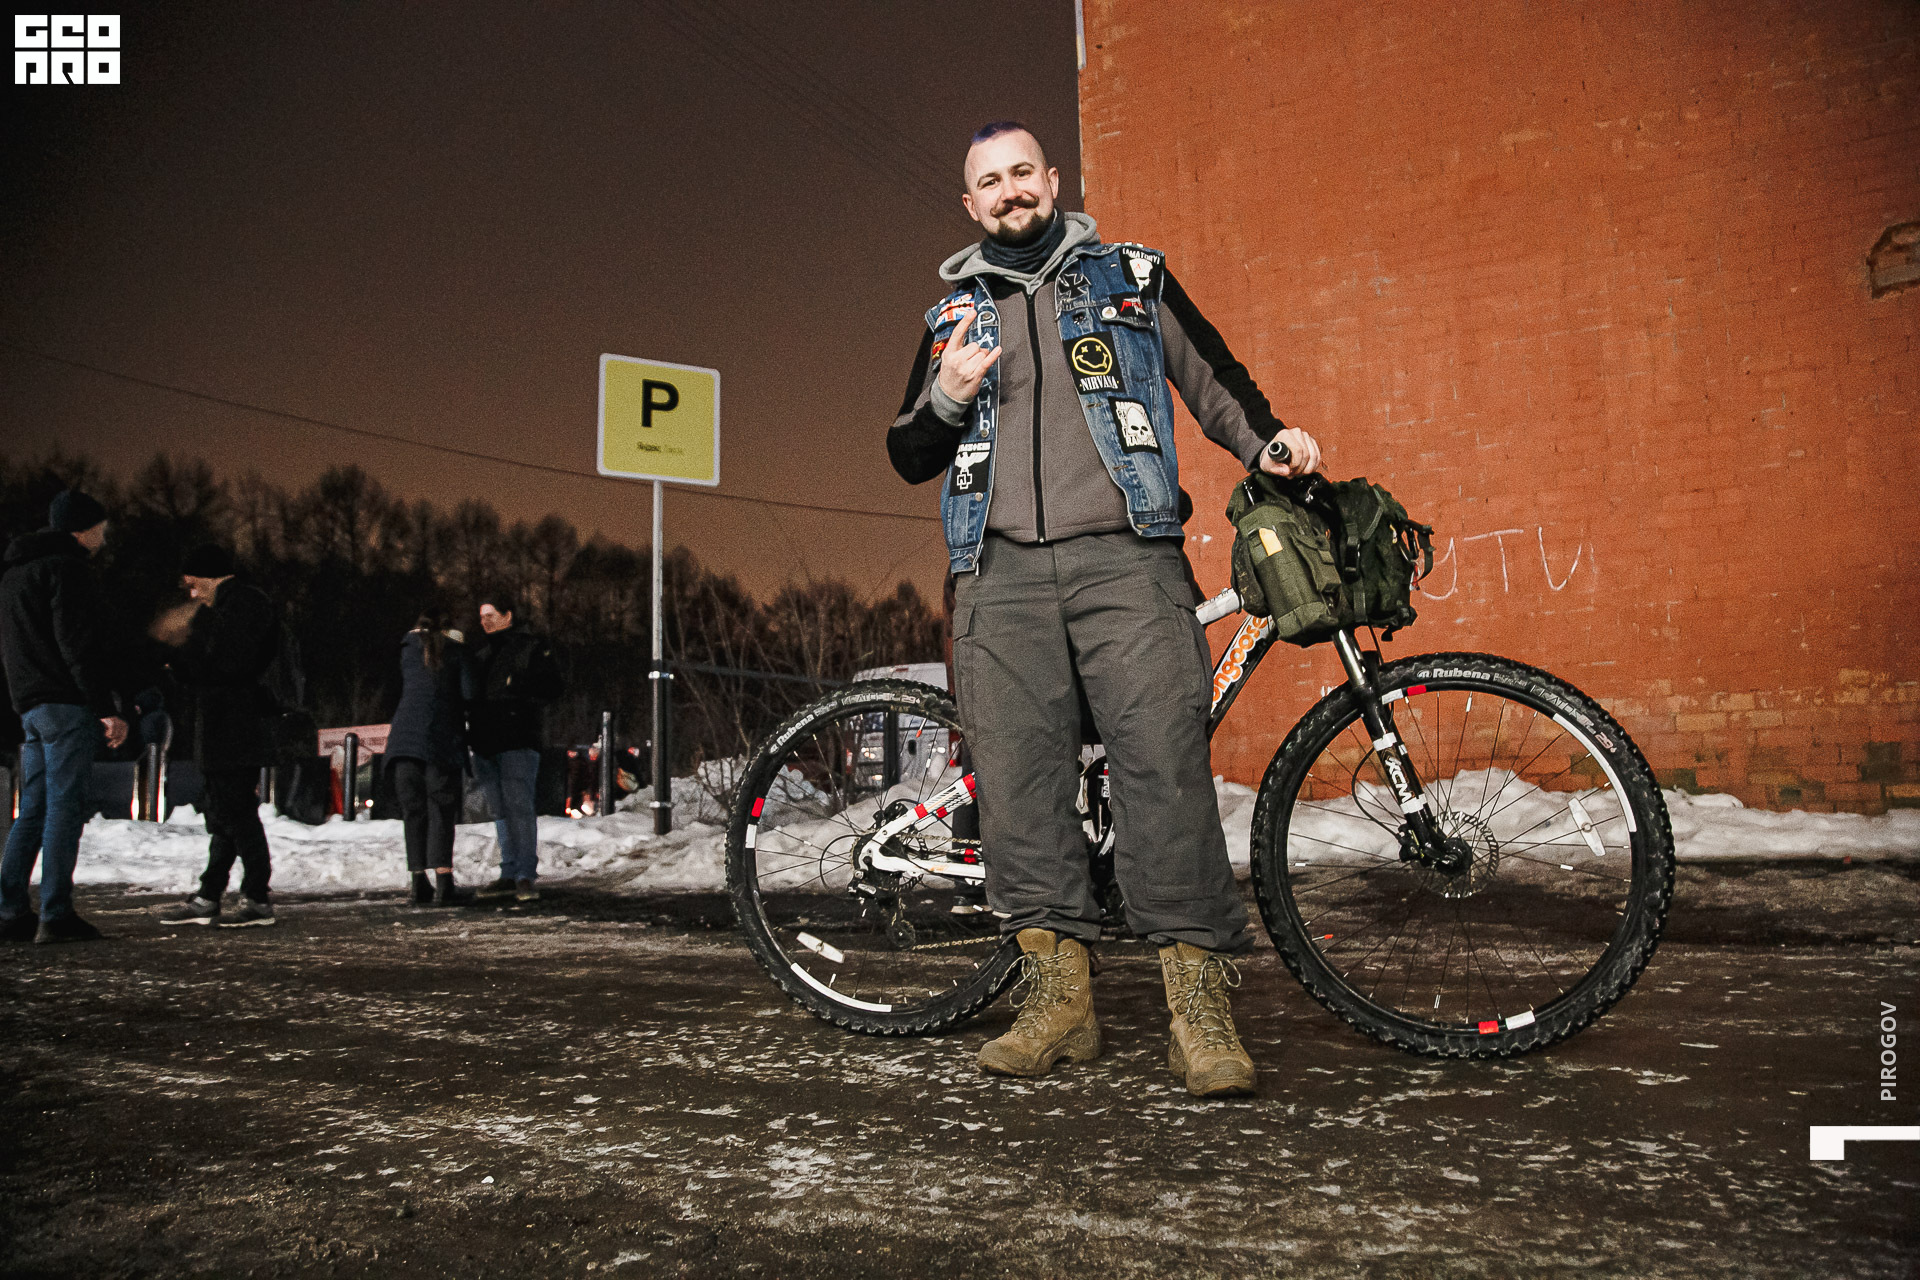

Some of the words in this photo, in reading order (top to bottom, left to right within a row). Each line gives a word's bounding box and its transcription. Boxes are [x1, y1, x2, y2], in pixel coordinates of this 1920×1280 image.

[1080, 375, 1118, 391] NIRVANA
[641, 379, 680, 428] P
[1211, 616, 1268, 704] ongoose
[1432, 668, 1491, 681] Rubena
[776, 713, 815, 747] Rubena
[1385, 757, 1413, 803] XCM
